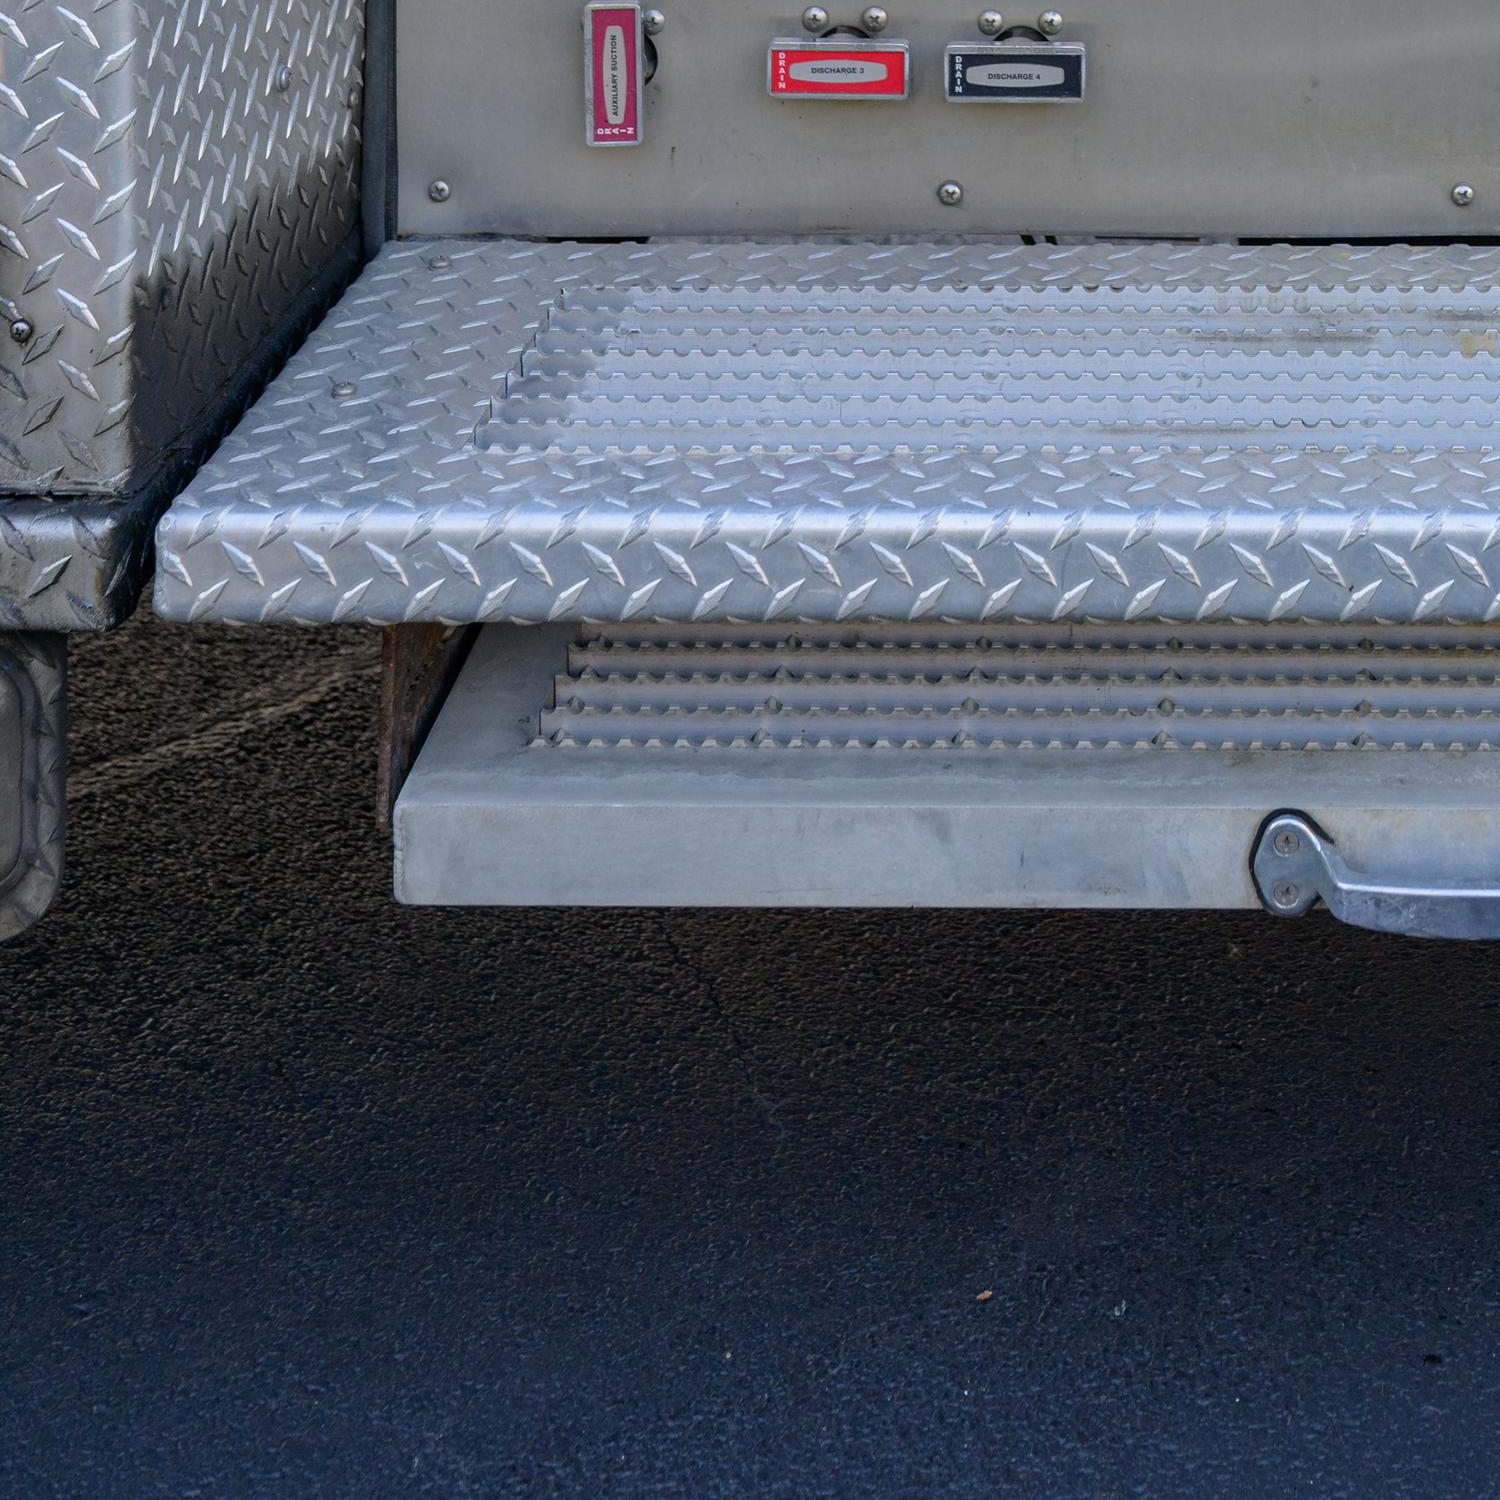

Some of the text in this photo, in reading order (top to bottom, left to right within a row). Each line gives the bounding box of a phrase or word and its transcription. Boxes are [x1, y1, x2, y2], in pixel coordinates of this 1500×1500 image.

[778, 52, 786, 89] DRAIN
[955, 55, 963, 93] DRAIN
[597, 127, 634, 135] DRAIN
